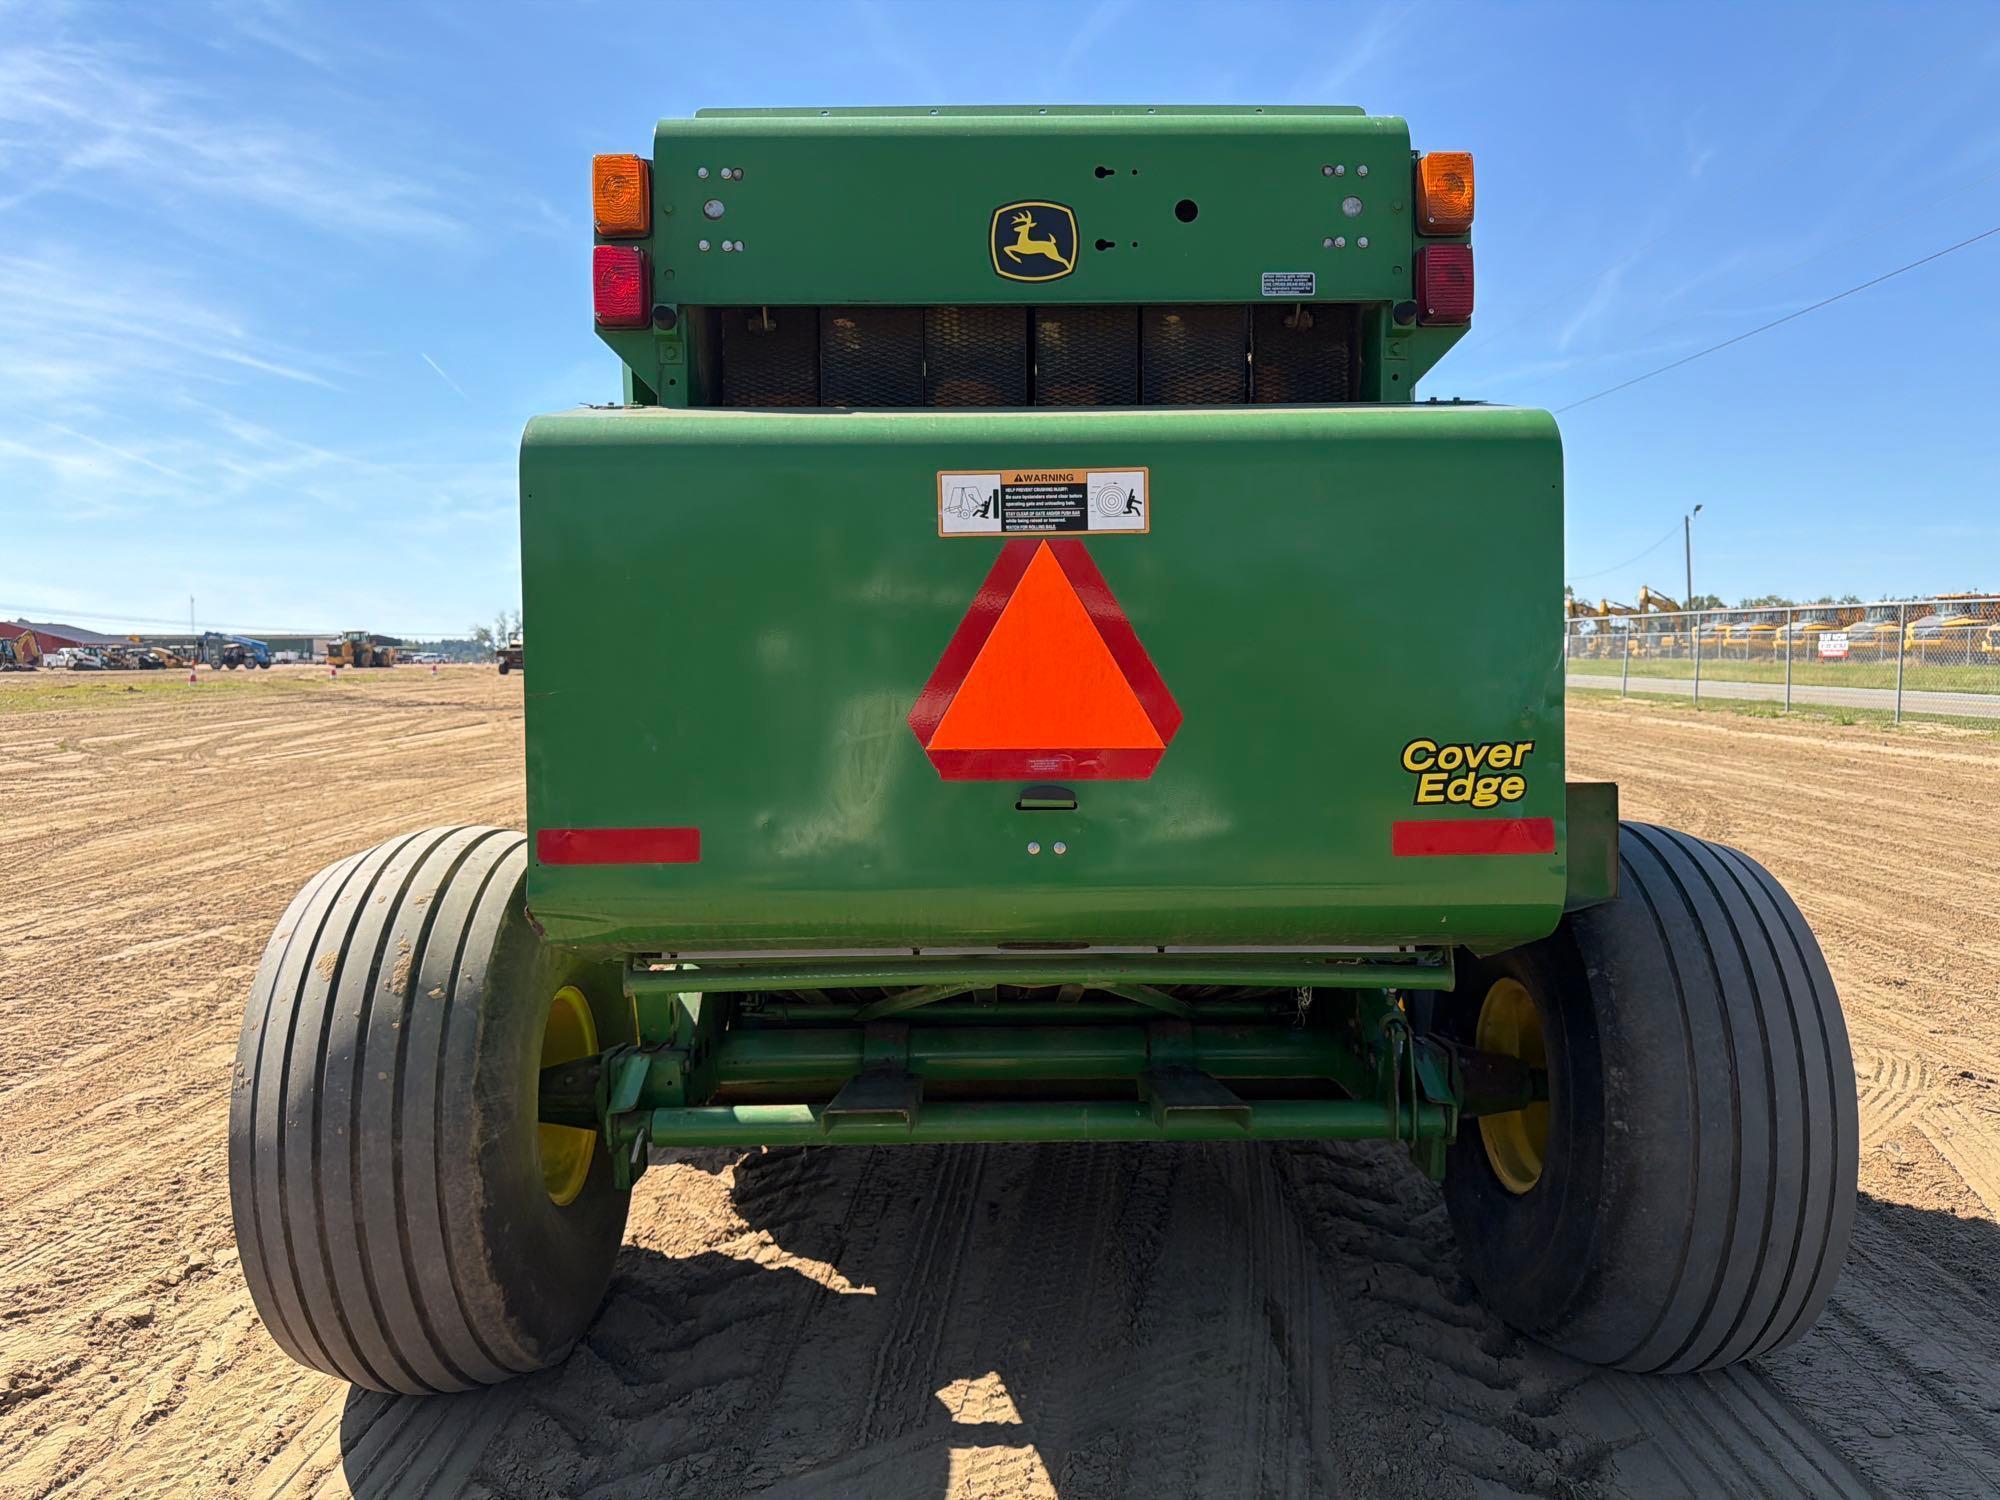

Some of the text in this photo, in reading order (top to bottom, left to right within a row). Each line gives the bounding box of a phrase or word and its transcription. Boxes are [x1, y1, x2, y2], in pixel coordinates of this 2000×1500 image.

[1023, 473, 1074, 482] WARNING
[1402, 738, 1534, 772] Cover
[1414, 771, 1526, 808] Edge
